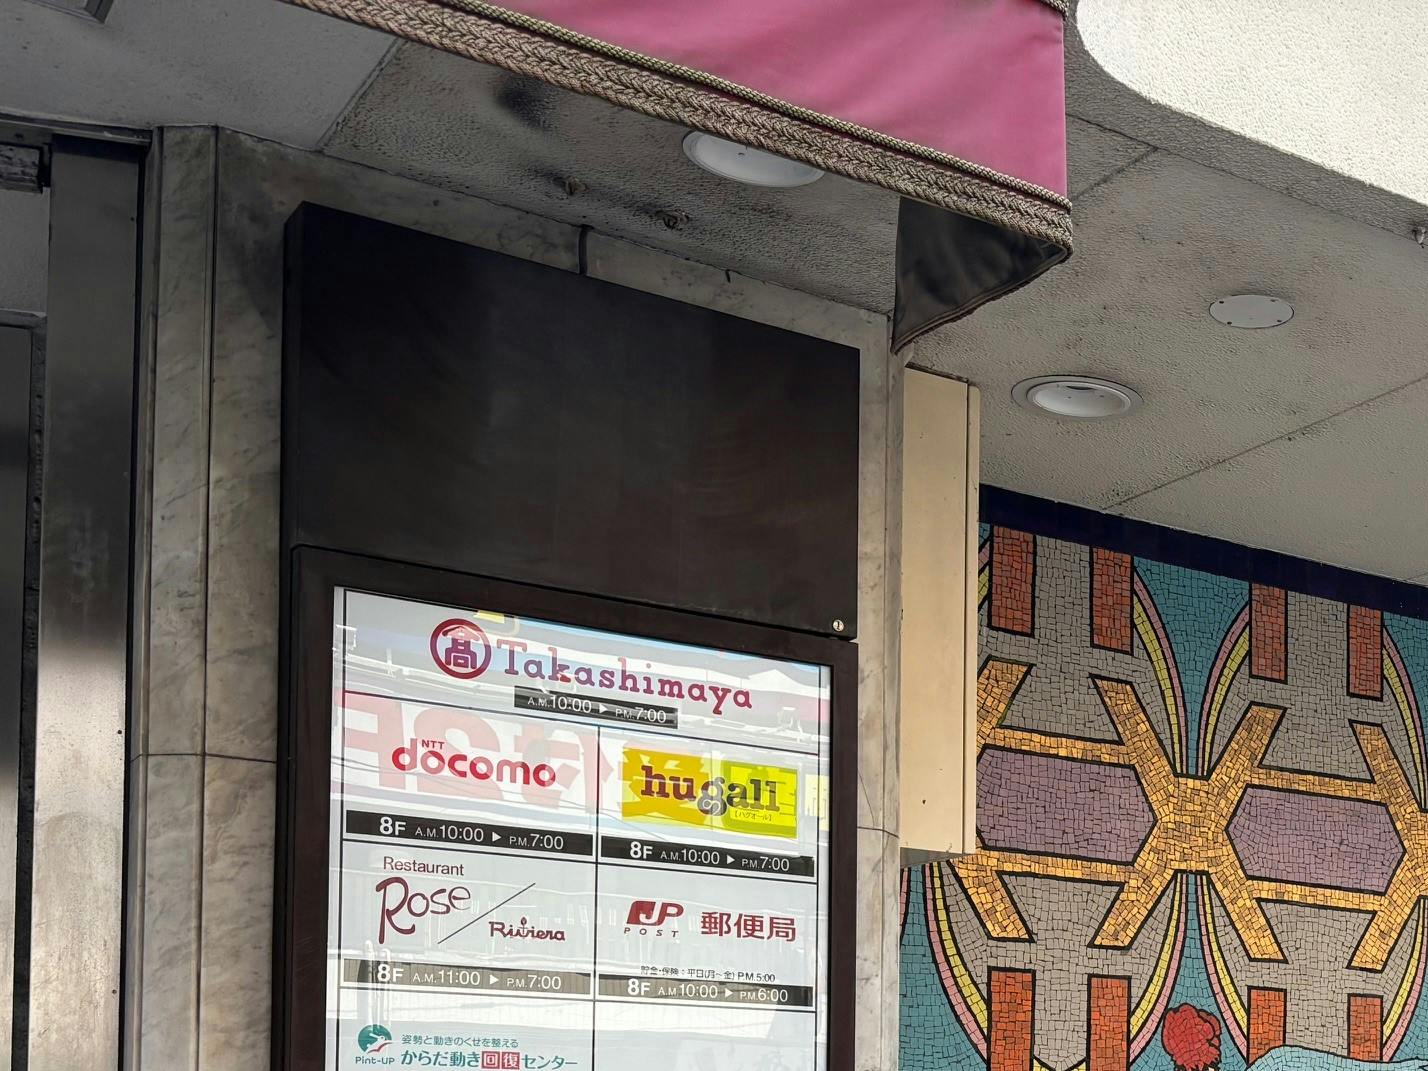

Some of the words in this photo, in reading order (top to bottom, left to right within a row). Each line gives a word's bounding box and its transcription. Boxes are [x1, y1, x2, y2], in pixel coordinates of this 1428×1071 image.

[496, 638, 753, 716] Takashimaya
[421, 739, 445, 750] NTT
[391, 738, 556, 788] docomo
[640, 764, 781, 817] hugall
[379, 816, 406, 836] 8F
[629, 841, 653, 859] 8F
[383, 856, 464, 876] Restaurant
[375, 876, 471, 945] Rose
[626, 900, 684, 927] JP
[488, 918, 566, 942] Riviera
[623, 927, 679, 938] POST
[700, 911, 797, 942] 郵便局
[376, 964, 404, 983] 8F
[627, 977, 651, 996] 8F
[401, 1034, 519, 1048] 姿勢と動きのくせを整える
[400, 1050, 578, 1071] からだ動き回復センター
